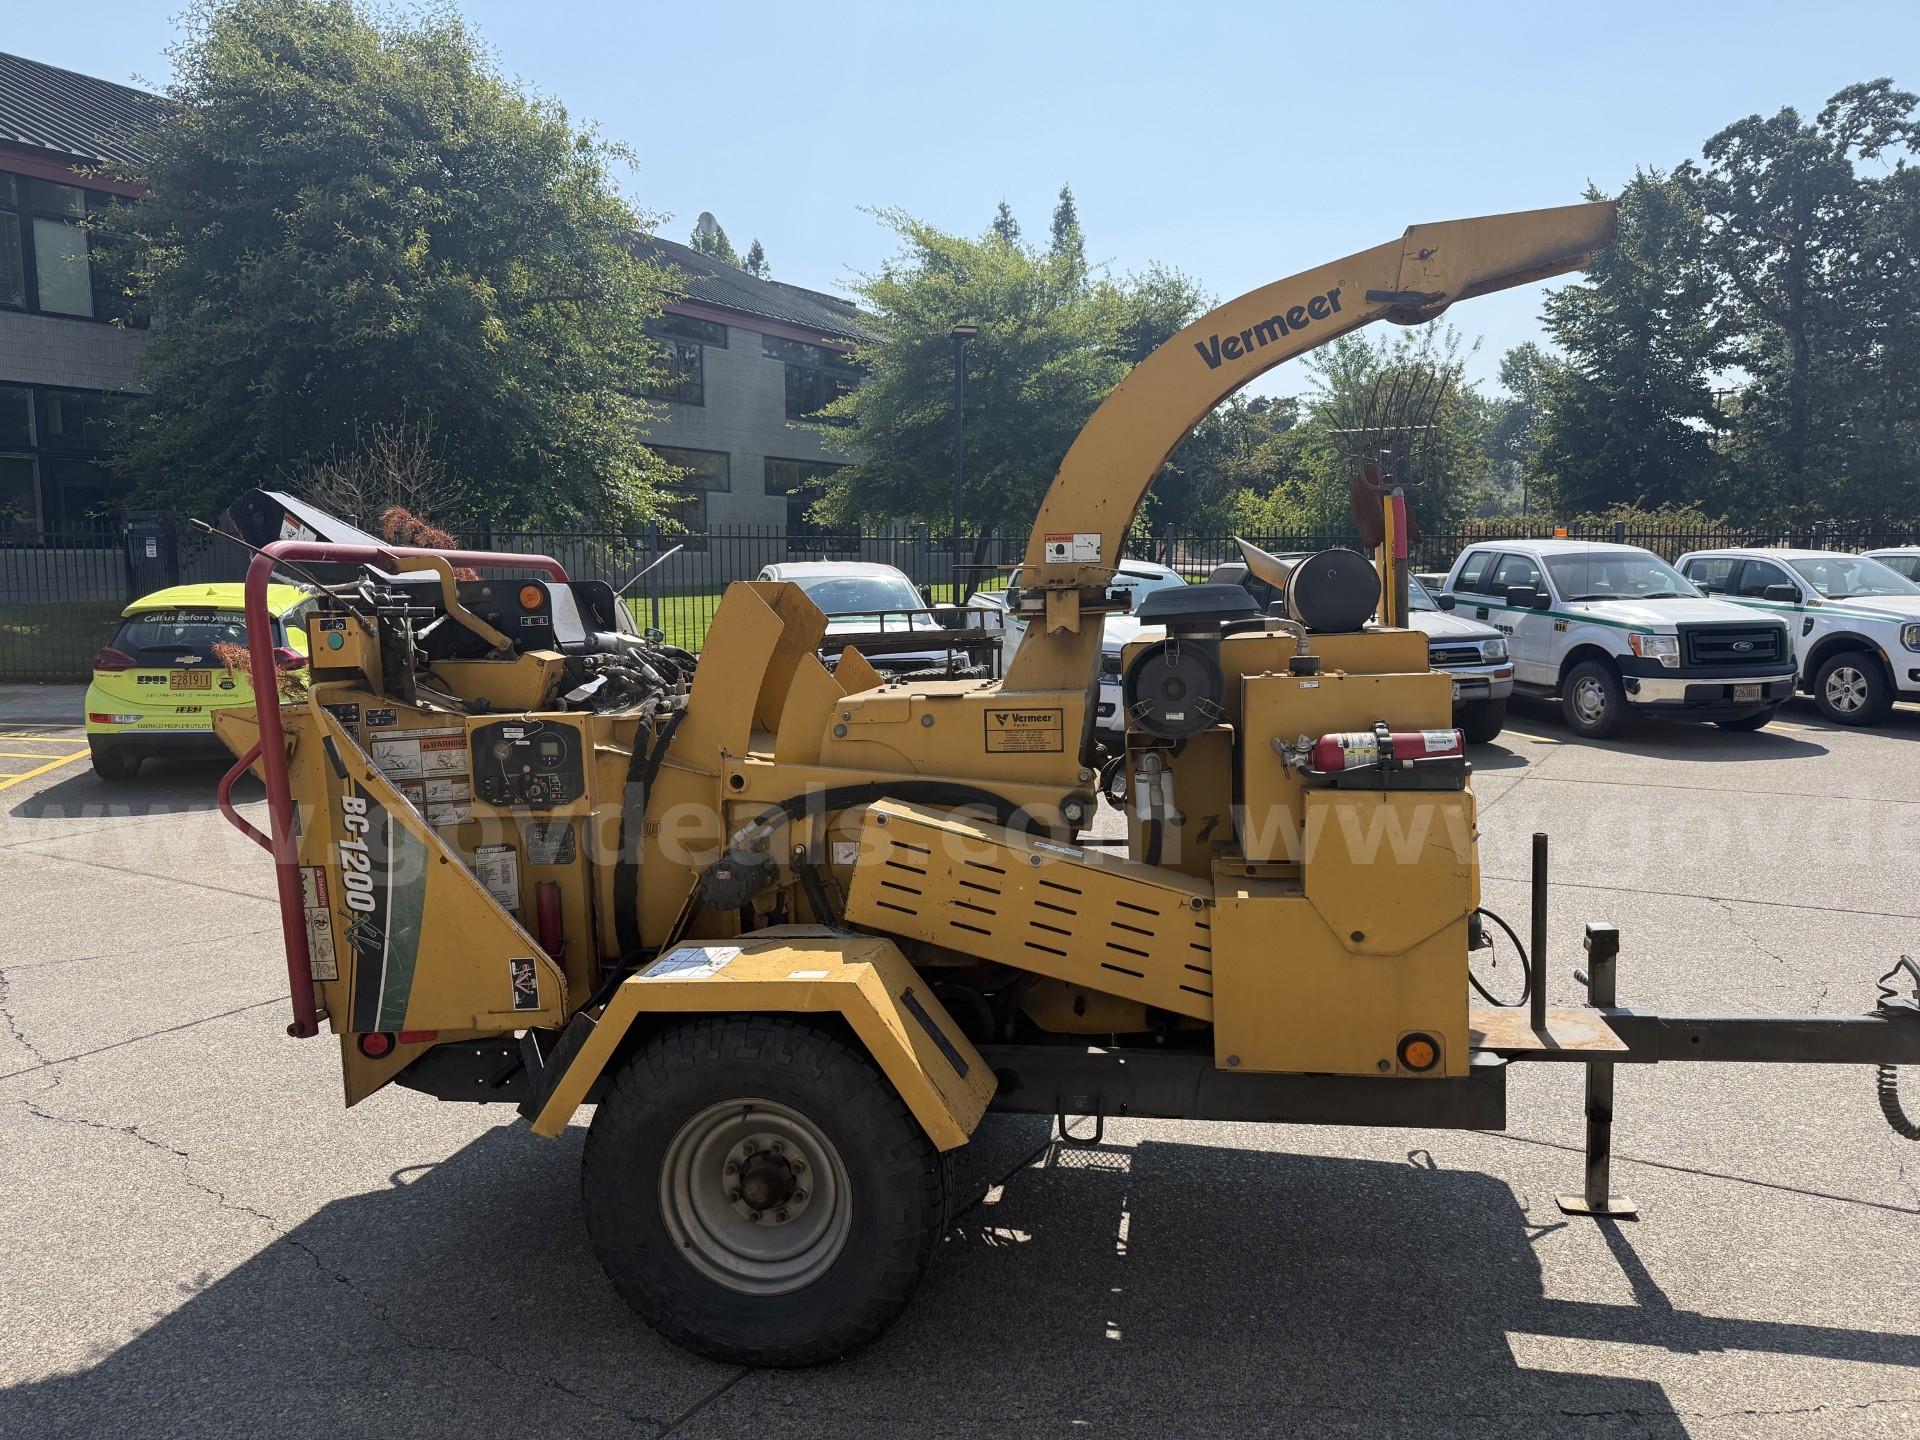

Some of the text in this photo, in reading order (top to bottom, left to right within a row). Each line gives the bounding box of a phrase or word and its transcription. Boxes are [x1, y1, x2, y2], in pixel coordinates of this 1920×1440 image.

[1194, 288, 1342, 370] Vermeer
[211, 615, 230, 623] you
[232, 615, 246, 623] bu
[171, 673, 209, 686] E281911
[1011, 713, 1052, 723] Vermeer
[340, 796, 376, 912] BC-1200
[476, 845, 507, 855] Vermeer
